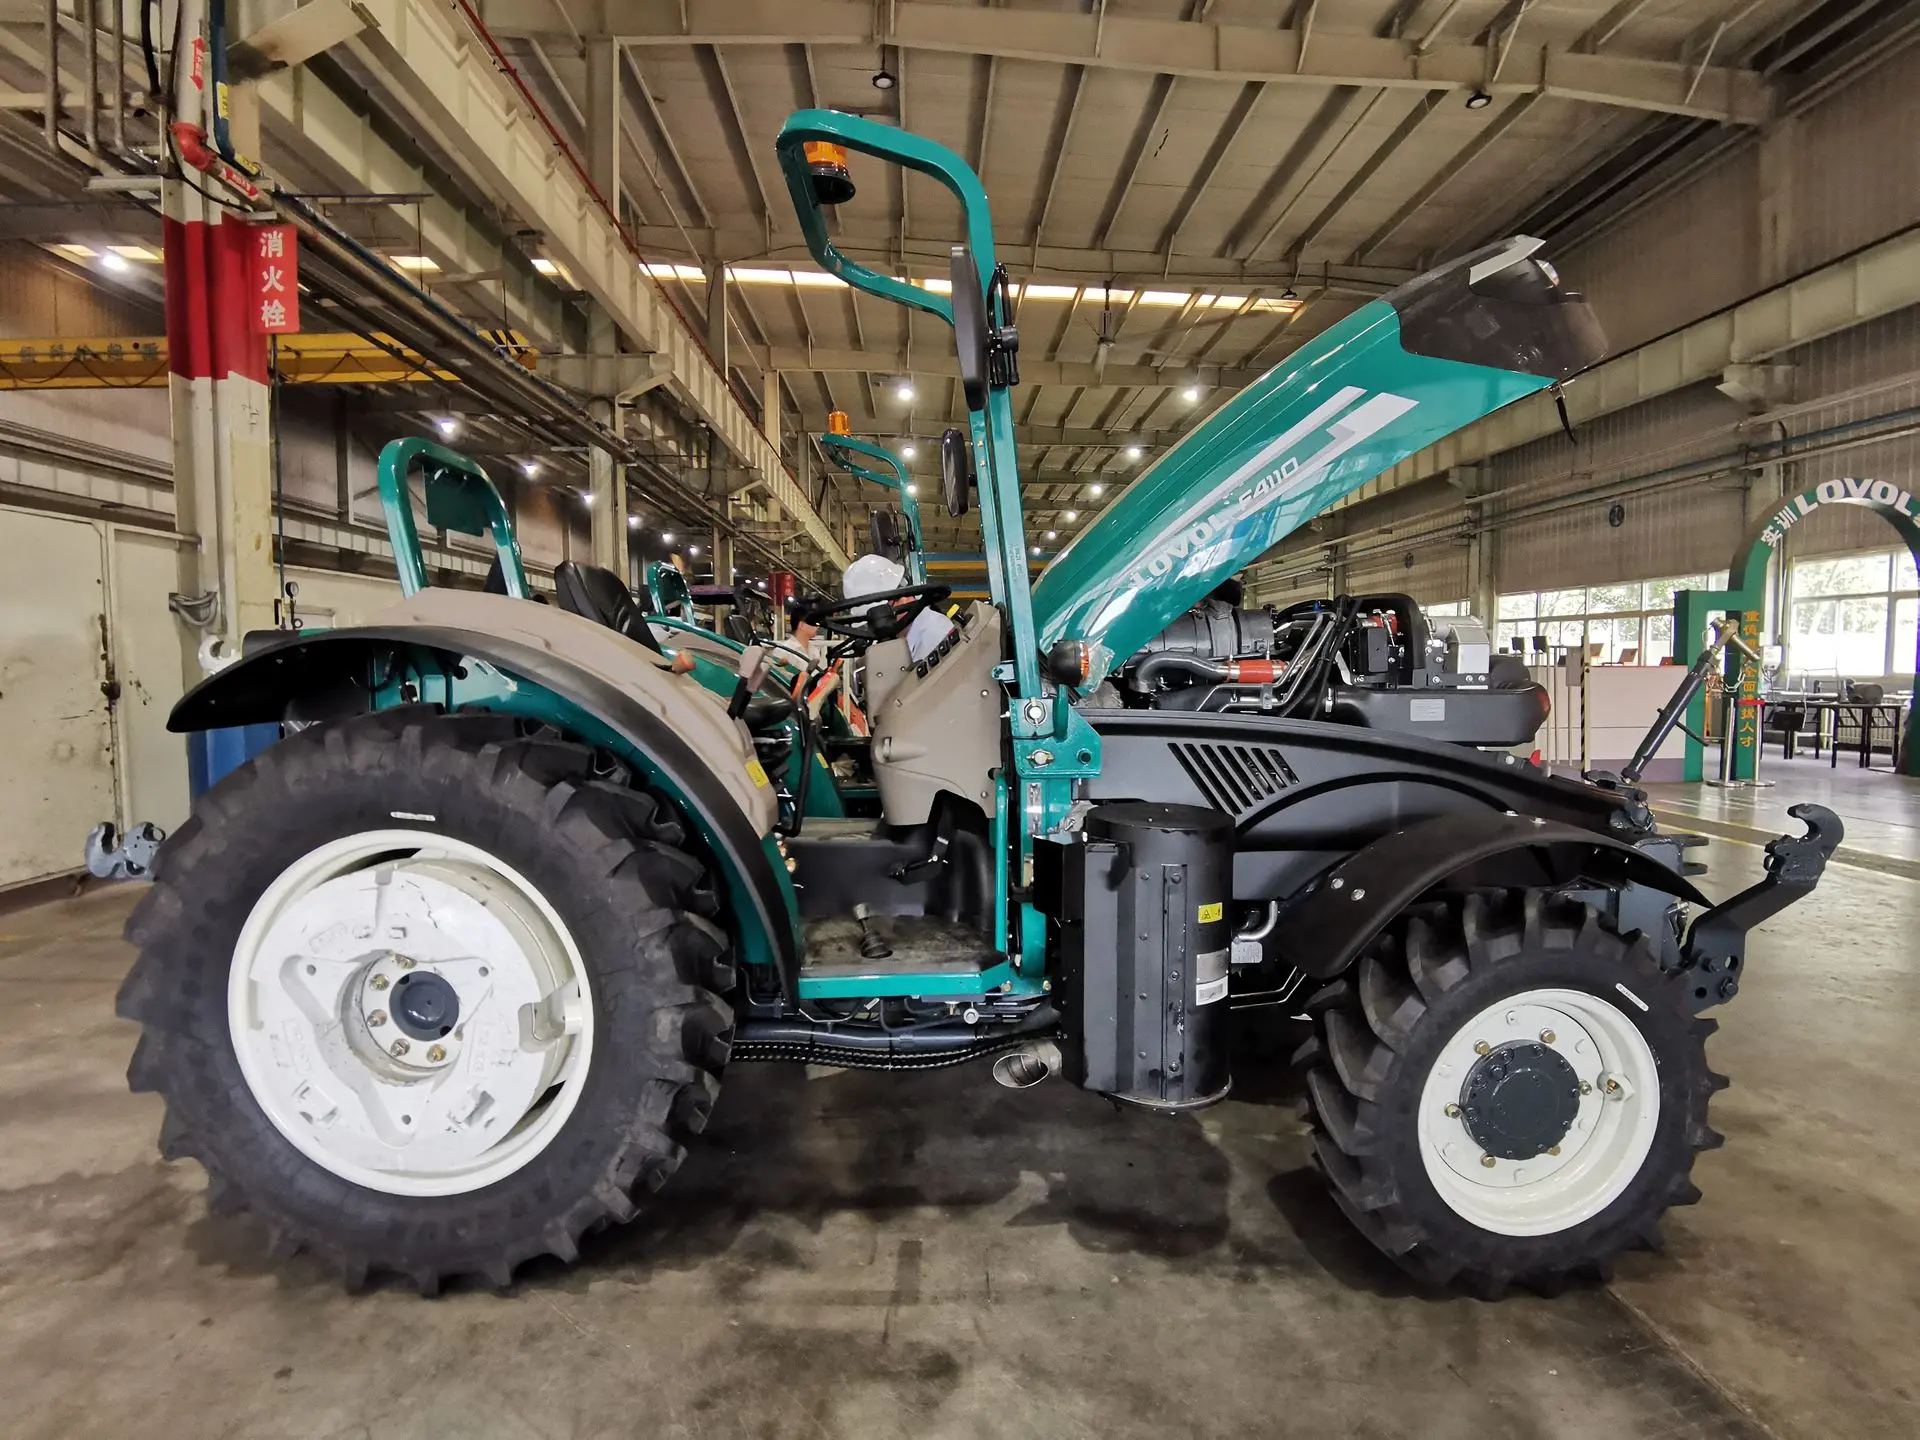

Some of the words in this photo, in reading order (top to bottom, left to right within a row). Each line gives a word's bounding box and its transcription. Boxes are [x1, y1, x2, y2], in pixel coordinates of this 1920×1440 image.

[260, 230, 286, 328] 消火栓
[1794, 477, 1912, 517] LOVOL
[1129, 513, 1231, 588] LOVOL
